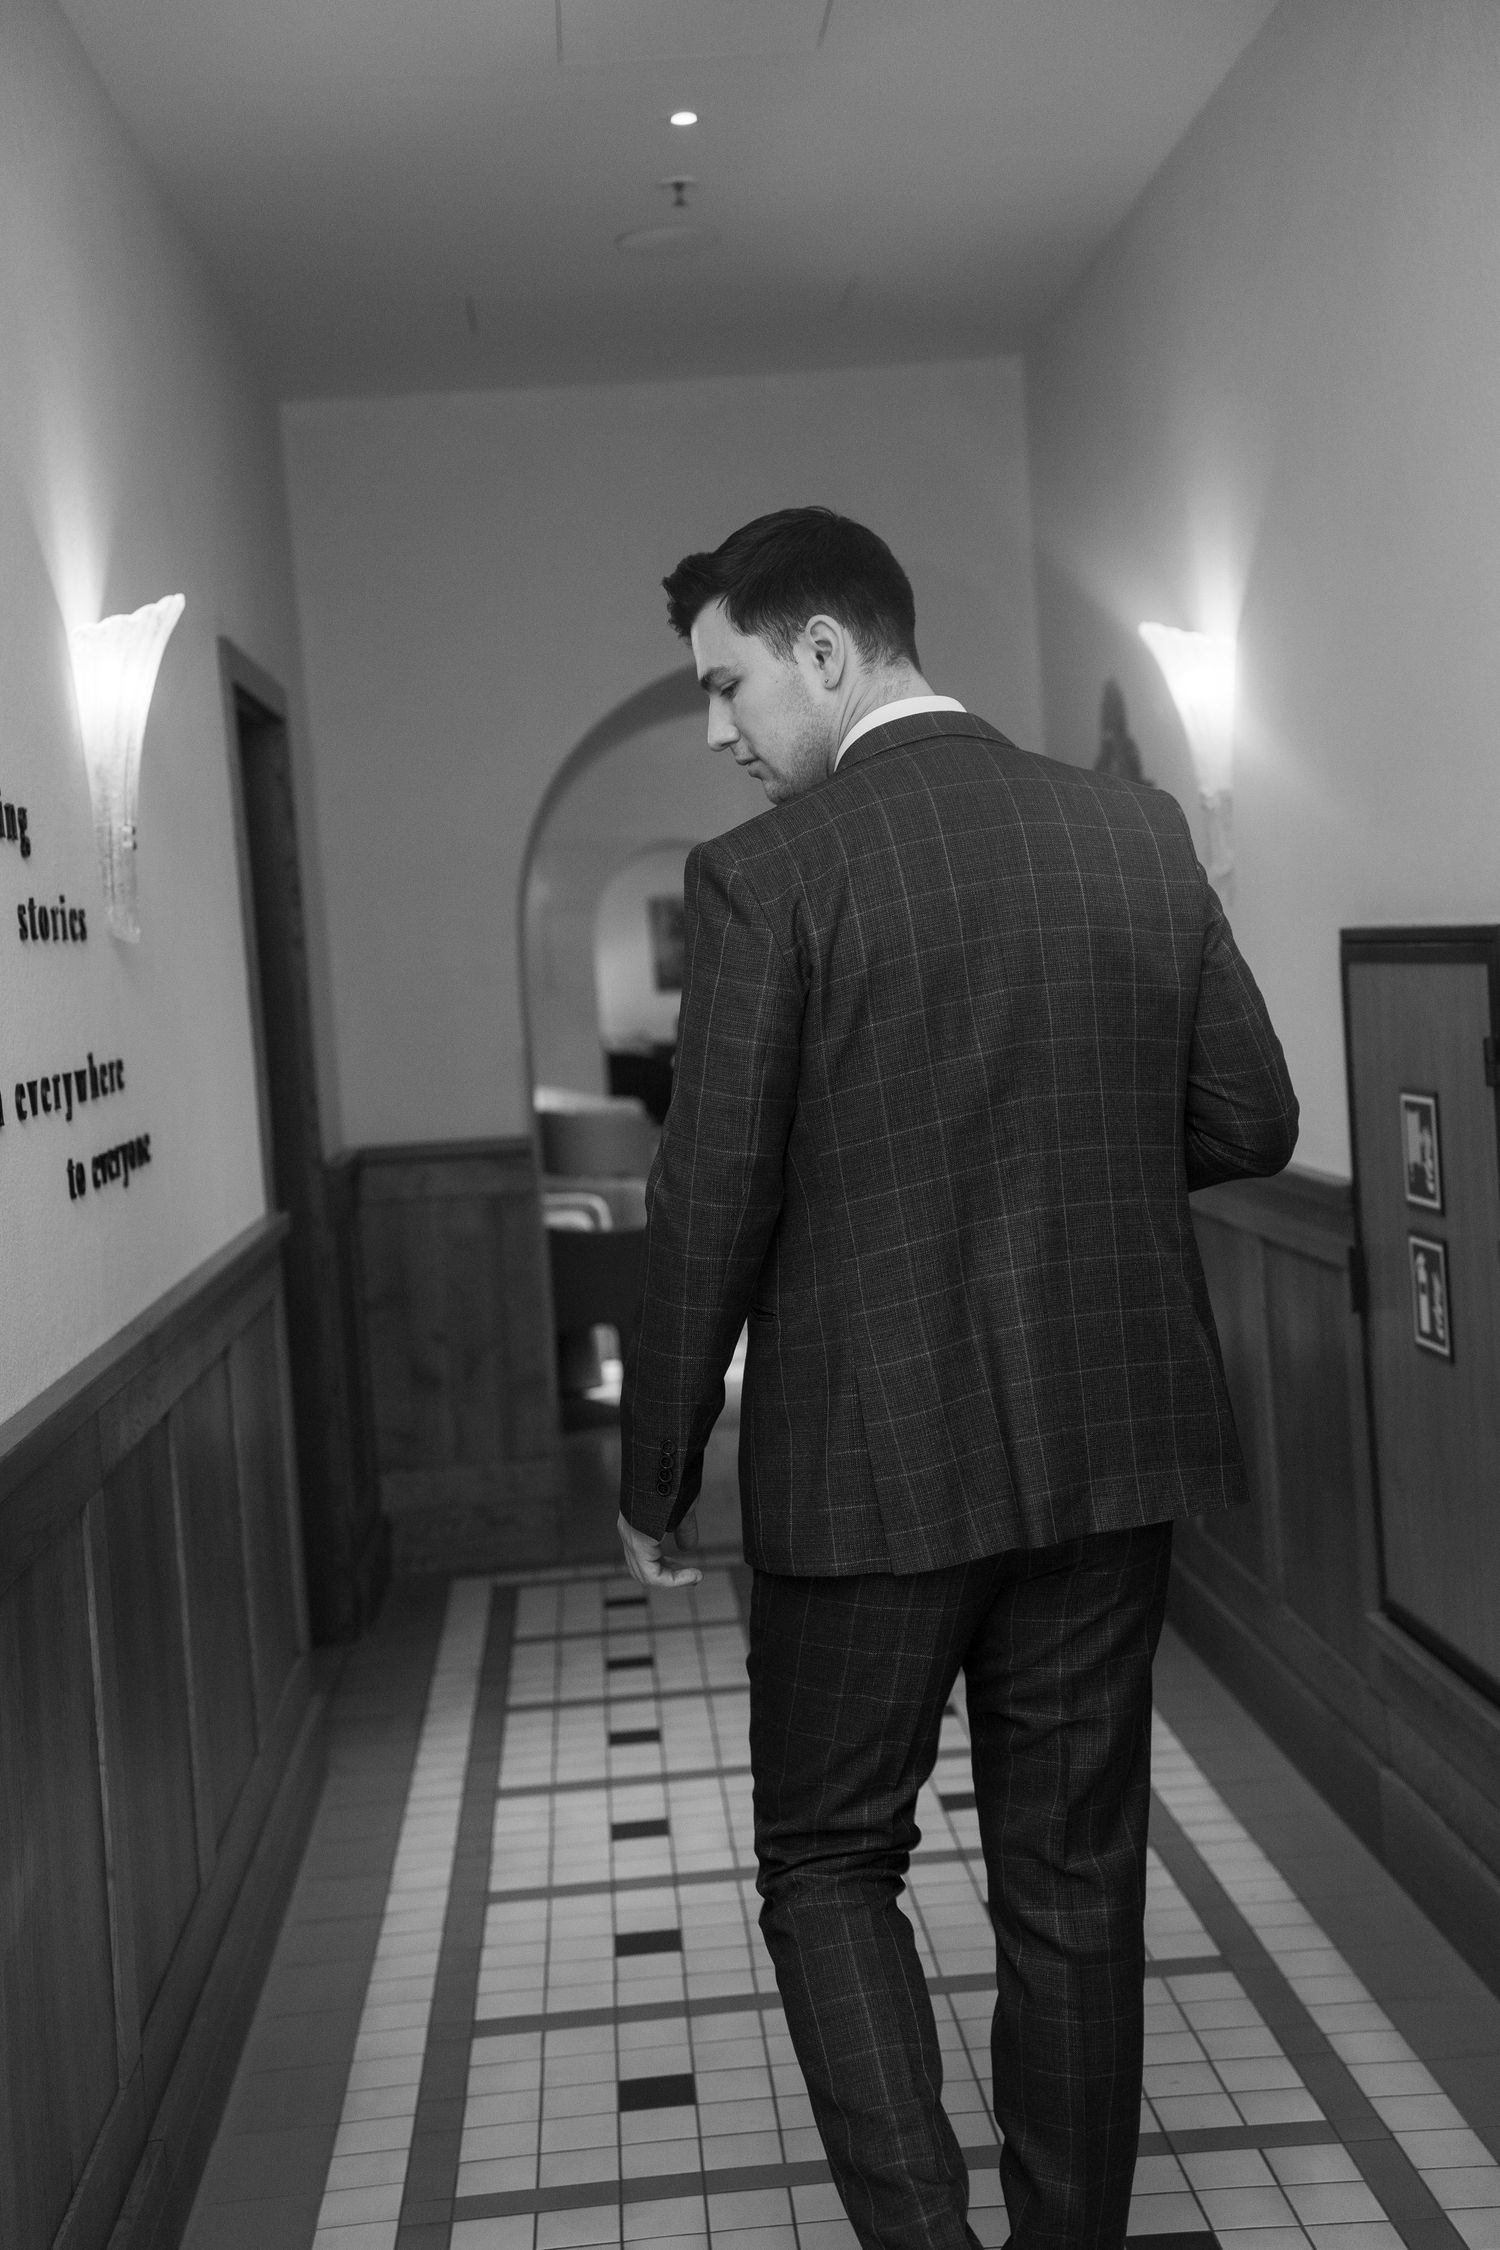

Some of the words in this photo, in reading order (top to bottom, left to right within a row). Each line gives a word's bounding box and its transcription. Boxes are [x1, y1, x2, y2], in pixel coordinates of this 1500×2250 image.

[17, 894, 88, 942] stories
[15, 1051, 125, 1122] everywhere
[67, 1158, 86, 1200] to
